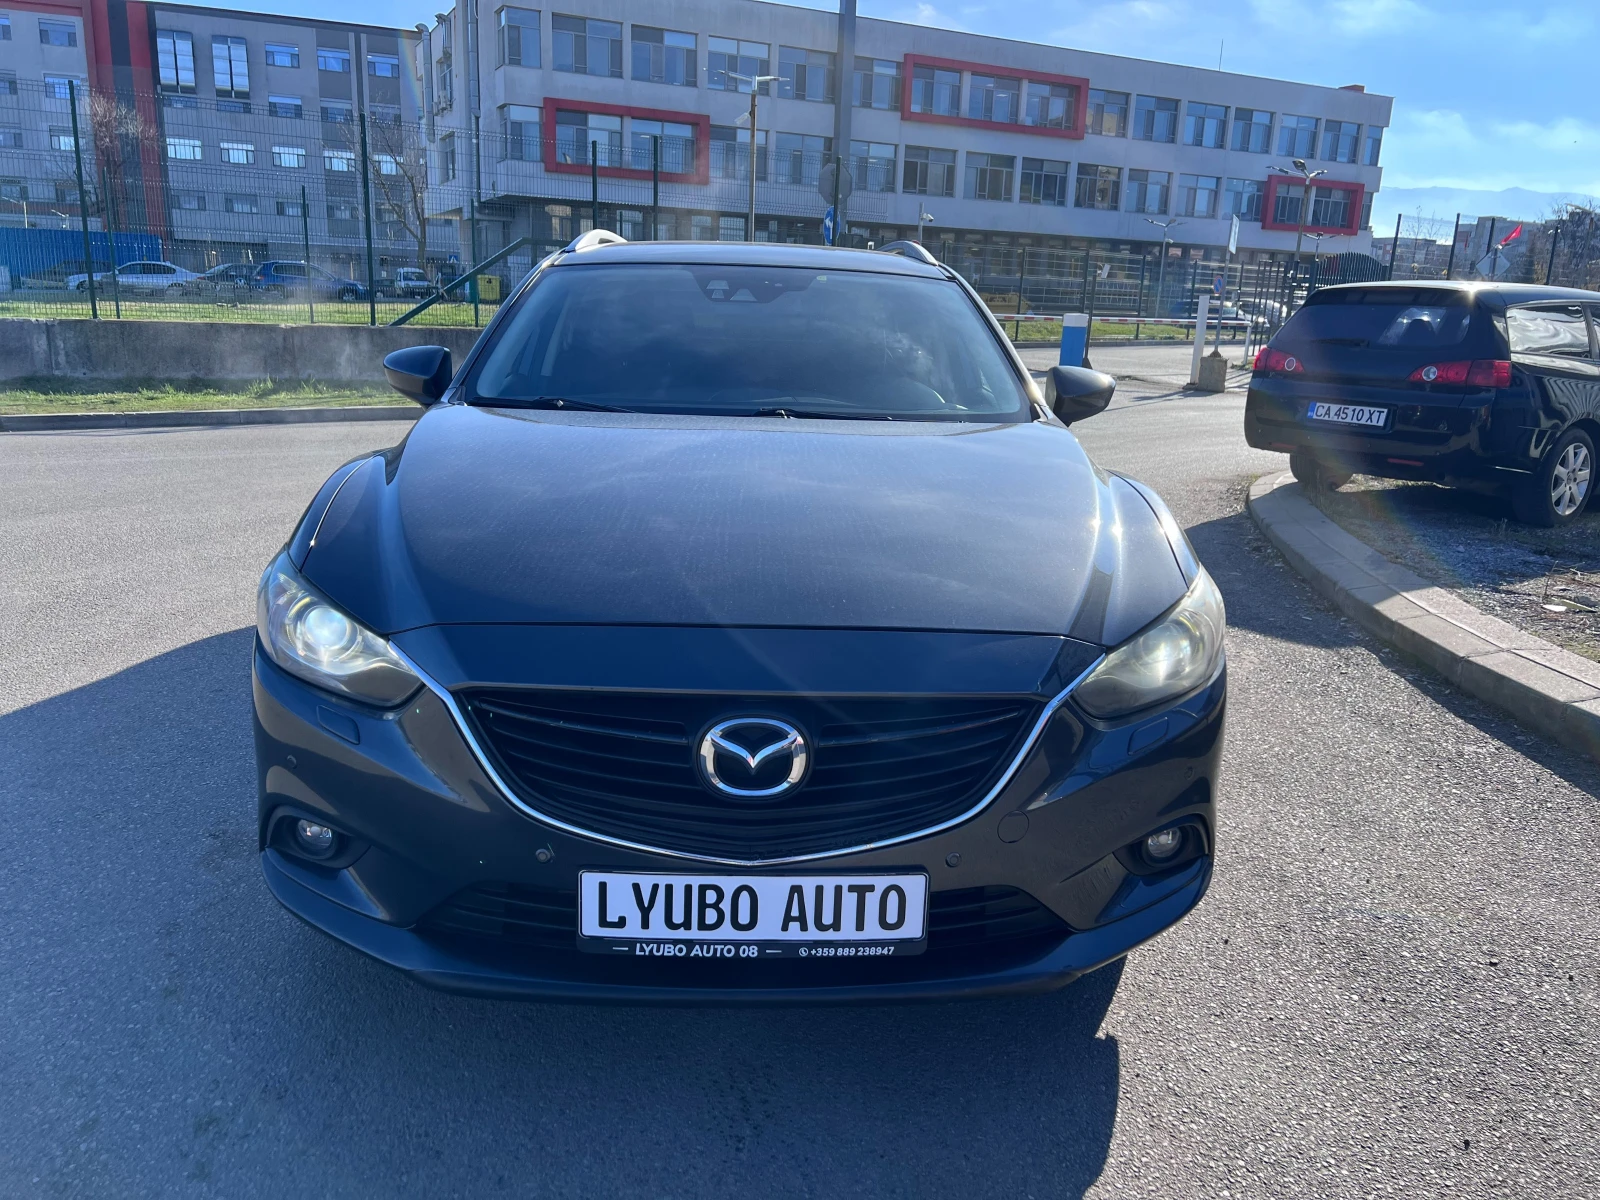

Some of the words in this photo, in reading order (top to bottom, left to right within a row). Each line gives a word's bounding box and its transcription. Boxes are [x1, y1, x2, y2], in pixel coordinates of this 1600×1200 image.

[1315, 405, 1331, 419] CA
[1334, 406, 1365, 422] 4510
[1366, 409, 1385, 424] XT
[598, 880, 759, 932] LYUBO
[781, 884, 907, 932] AUTO
[635, 943, 687, 957] LYUBO
[690, 944, 735, 957] AUTO
[739, 945, 758, 958] 08
[810, 947, 835, 957] +359
[836, 947, 856, 956] 889
[857, 946, 895, 956] 238947
